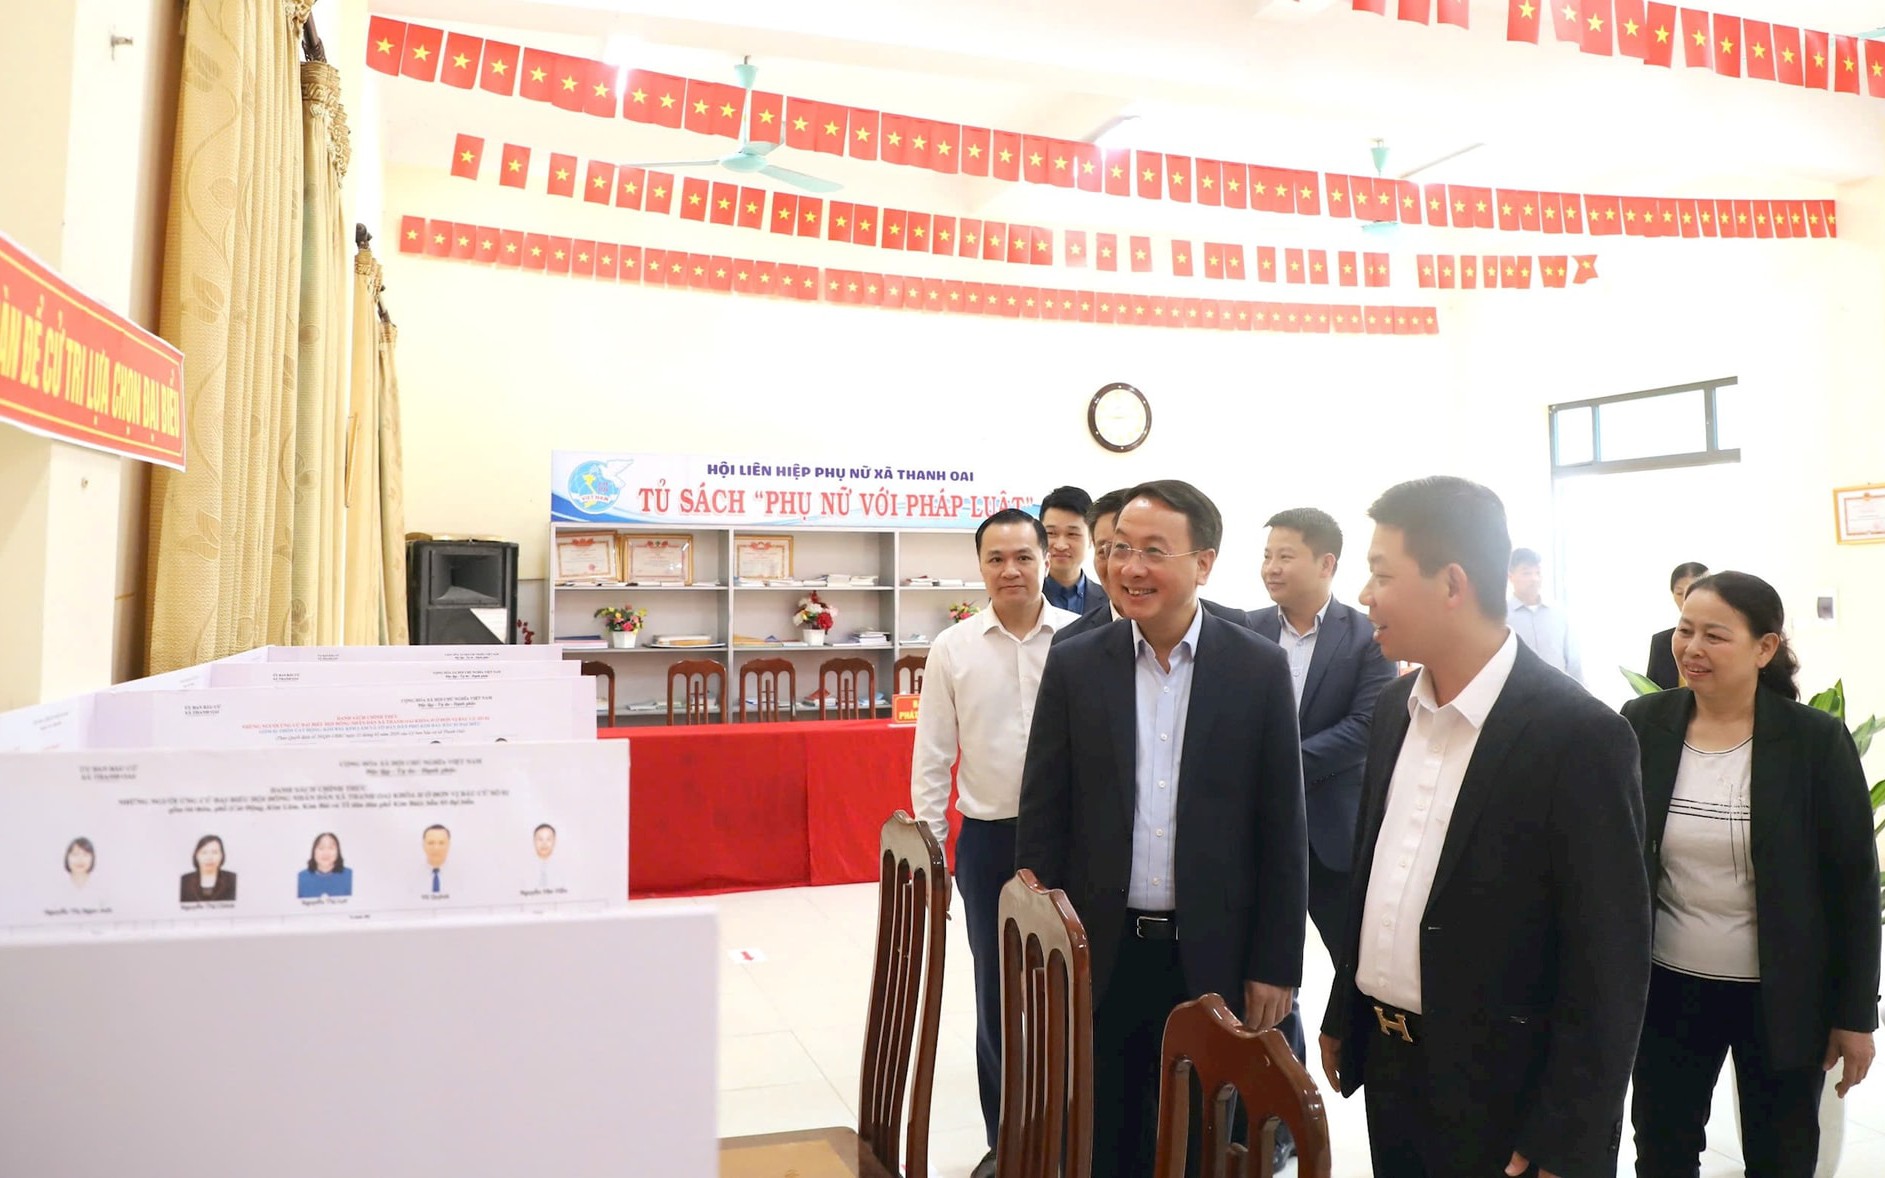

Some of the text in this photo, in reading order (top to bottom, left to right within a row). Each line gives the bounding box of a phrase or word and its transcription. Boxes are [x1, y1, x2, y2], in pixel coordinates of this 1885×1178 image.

[42, 310, 66, 398] CỬ
[65, 337, 87, 407] TRI
[86, 349, 110, 426] LỰA
[112, 362, 142, 435] CHỌN
[161, 368, 181, 439] BIỂU
[707, 461, 974, 482] HỘI LIÊN HIỆP PHỤ NỮ XÃ THANH OAI
[638, 478, 671, 513] TỦ
[680, 482, 745, 514] SÁCH
[820, 486, 853, 516] NỮ
[859, 486, 898, 516] VỚI
[906, 488, 963, 518] PHÁP
[1373, 1005, 1414, 1043] H
